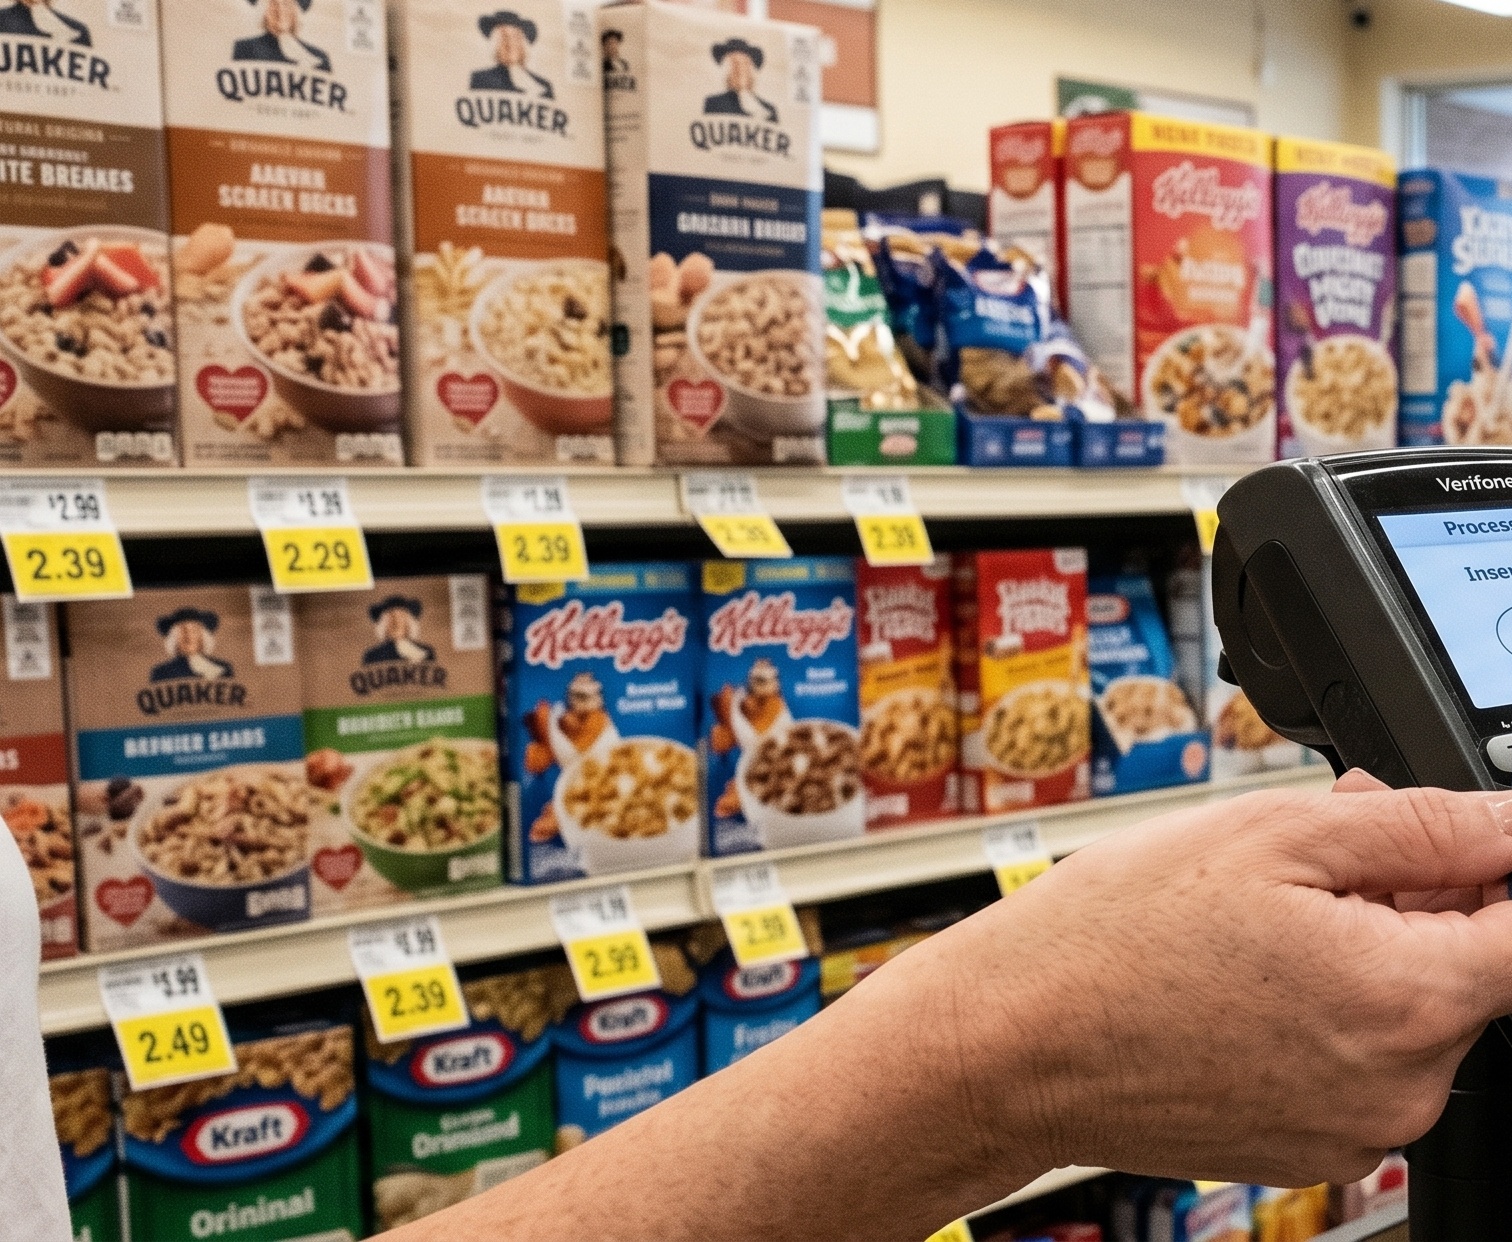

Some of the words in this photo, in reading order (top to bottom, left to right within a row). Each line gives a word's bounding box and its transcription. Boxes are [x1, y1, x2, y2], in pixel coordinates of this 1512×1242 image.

[215, 68, 349, 113] QUAKER
[455, 97, 569, 138] QUAKER
[689, 120, 792, 158] QUAKER
[26, 547, 107, 581] 2.39
[282, 540, 354, 574] 2.29
[525, 600, 689, 673] Kellogg's
[708, 590, 855, 660] Kellogg's
[136, 682, 247, 716] QUAKER
[349, 664, 448, 697] QUAKER
[584, 942, 641, 979] 2.99
[384, 980, 447, 1019] 2.39
[138, 1021, 209, 1065] 2.49
[432, 1041, 493, 1076] Kraft
[209, 1113, 283, 1151] Kraft
[189, 1188, 316, 1239] Orininal
